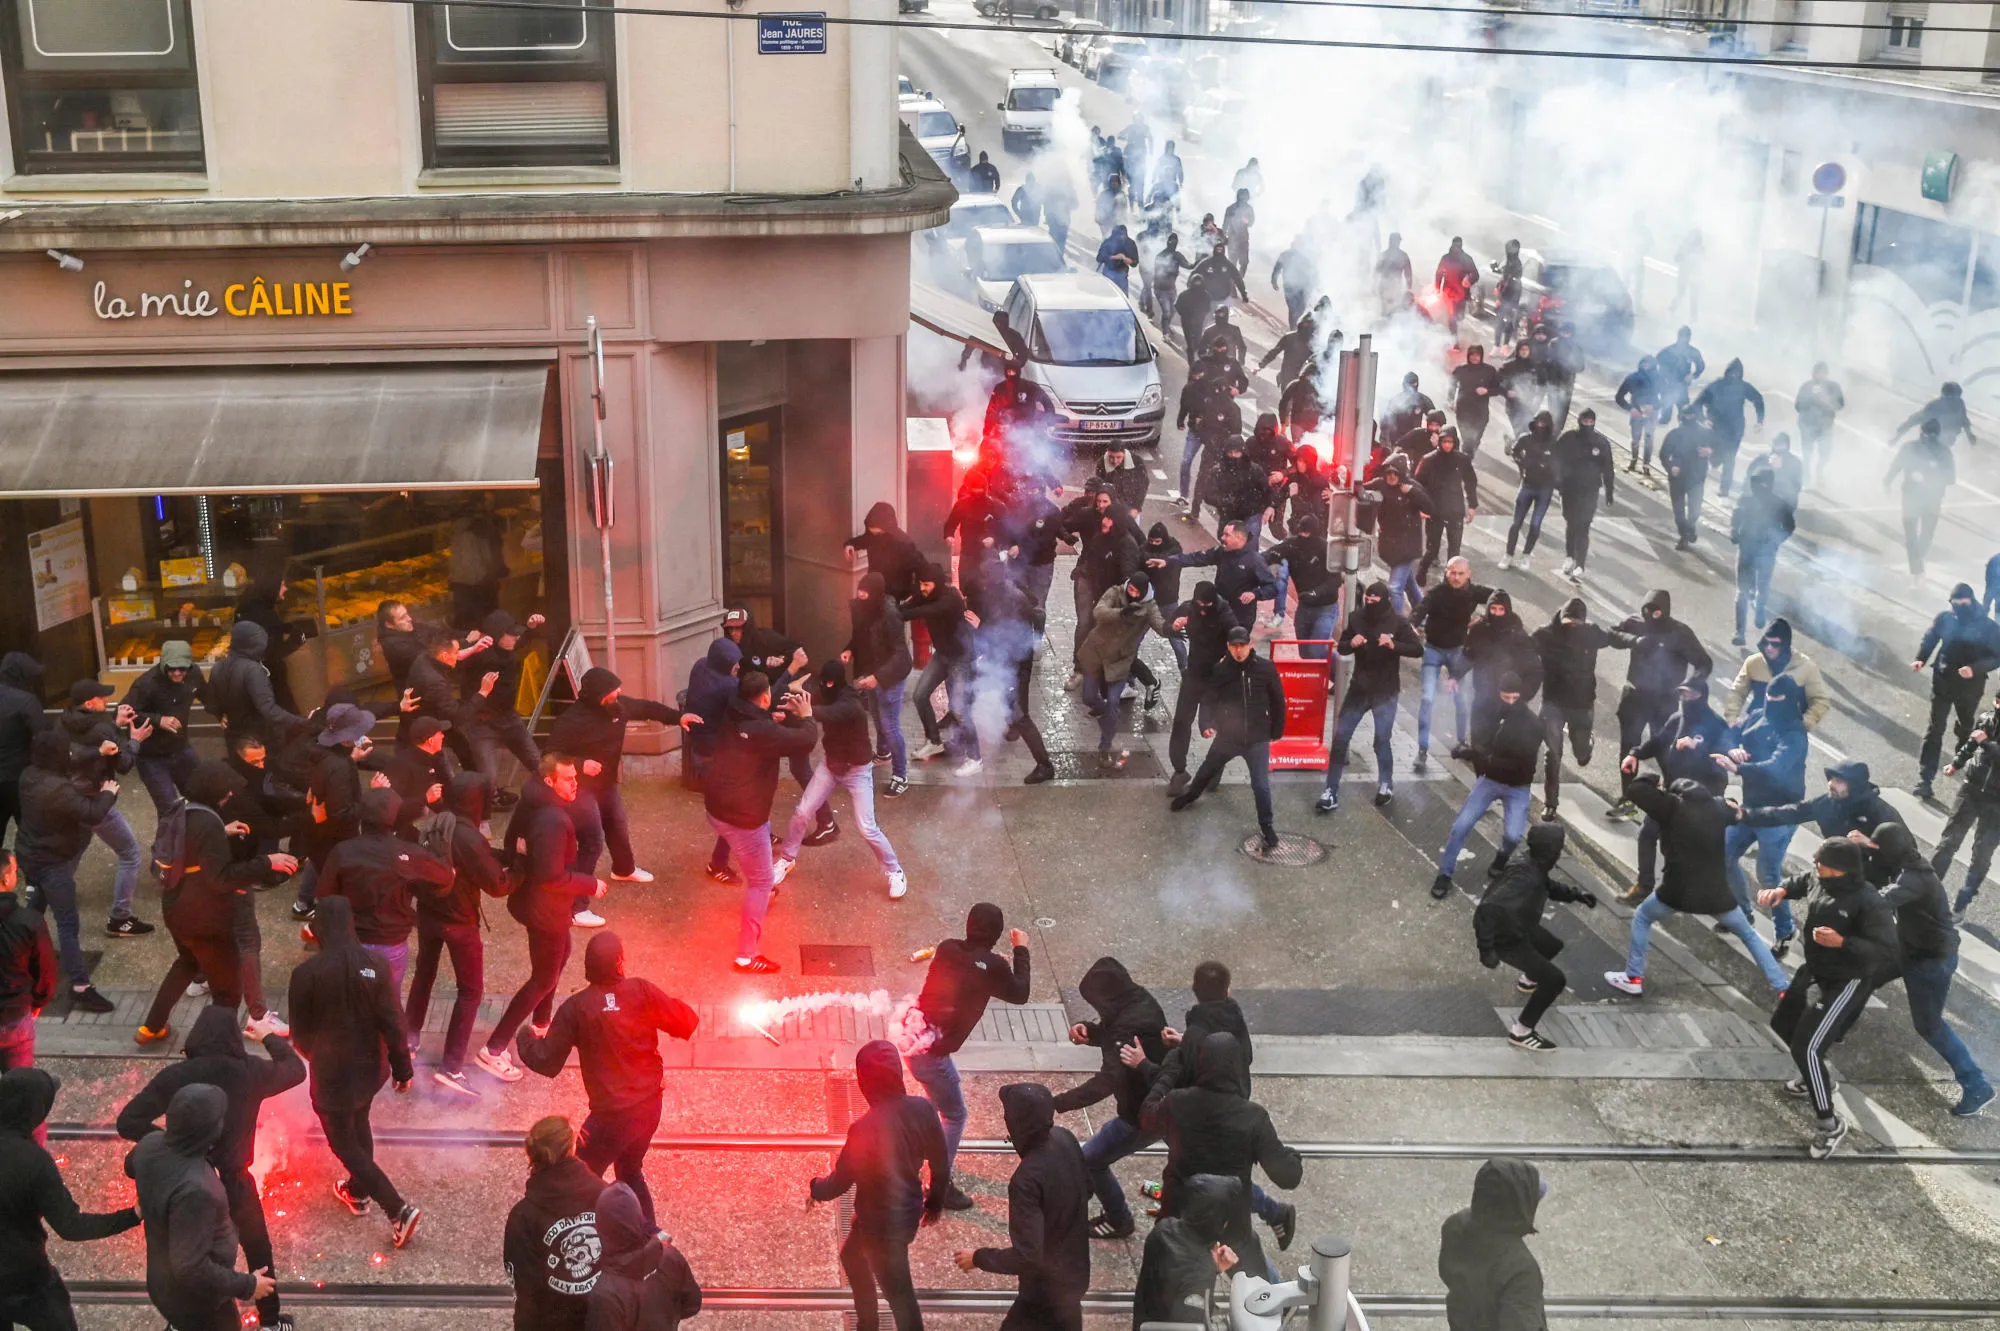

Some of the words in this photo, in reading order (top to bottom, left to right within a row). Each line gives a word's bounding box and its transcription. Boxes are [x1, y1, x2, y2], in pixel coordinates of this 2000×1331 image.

[761, 29, 783, 38] Jean
[785, 28, 824, 38] JAURES
[94, 280, 135, 319] la
[141, 279, 219, 317] mie
[224, 275, 352, 316] CÂLINE
[1285, 671, 1320, 679] Télégramme
[1269, 757, 1277, 765] Le
[1278, 756, 1326, 766] Télégramme
[559, 1218, 576, 1230] DAY
[580, 1213, 595, 1222] FOR
